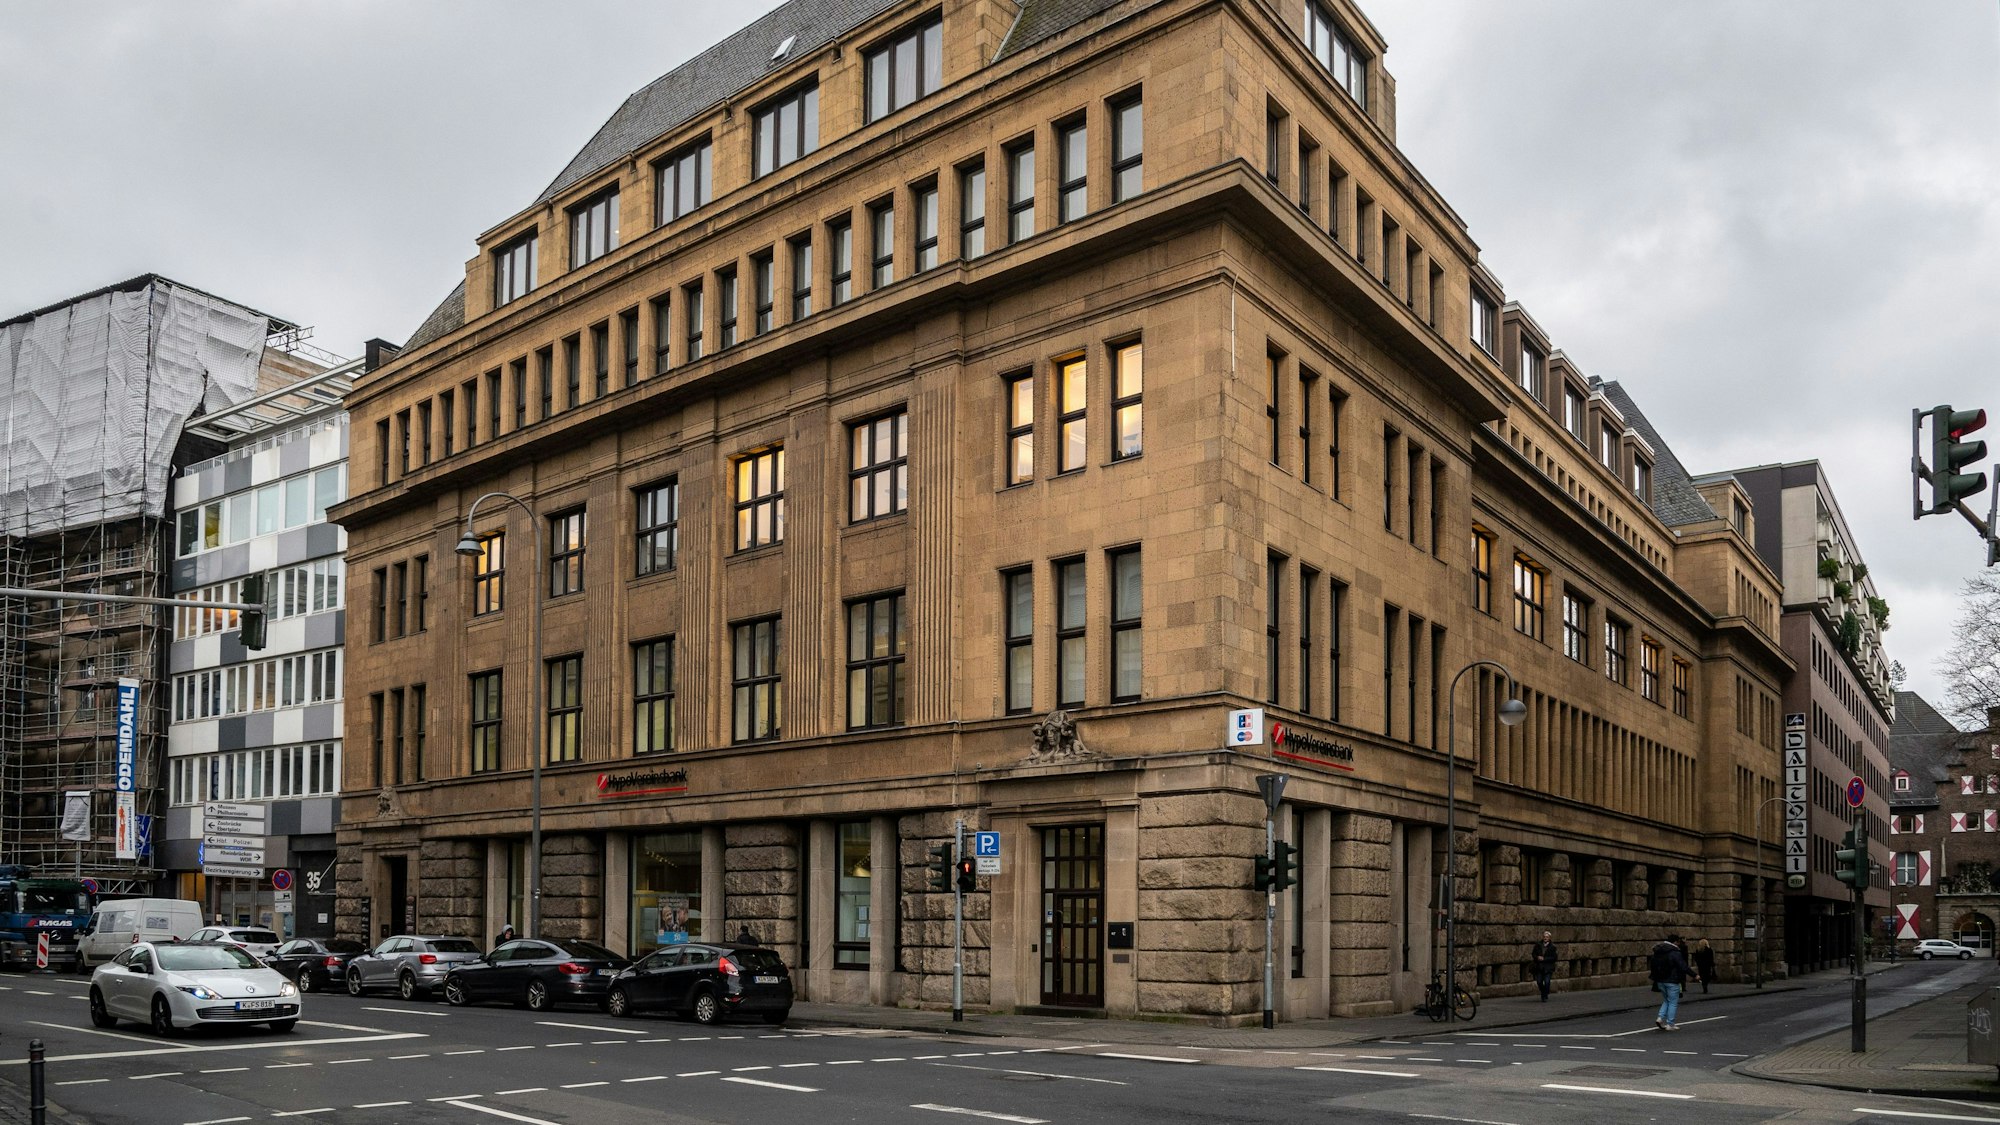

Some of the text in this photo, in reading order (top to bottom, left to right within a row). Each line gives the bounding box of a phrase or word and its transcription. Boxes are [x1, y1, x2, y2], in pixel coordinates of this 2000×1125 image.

[119, 688, 136, 791] ODENDAHL
[1284, 726, 1354, 762] HypoVereinsbank
[608, 767, 687, 791] HypoVereinsbank
[1788, 733, 1804, 871] DAITOAI
[205, 867, 252, 876] Bezirksregierung
[306, 871, 321, 889] 35
[39, 919, 72, 927] RAGAS
